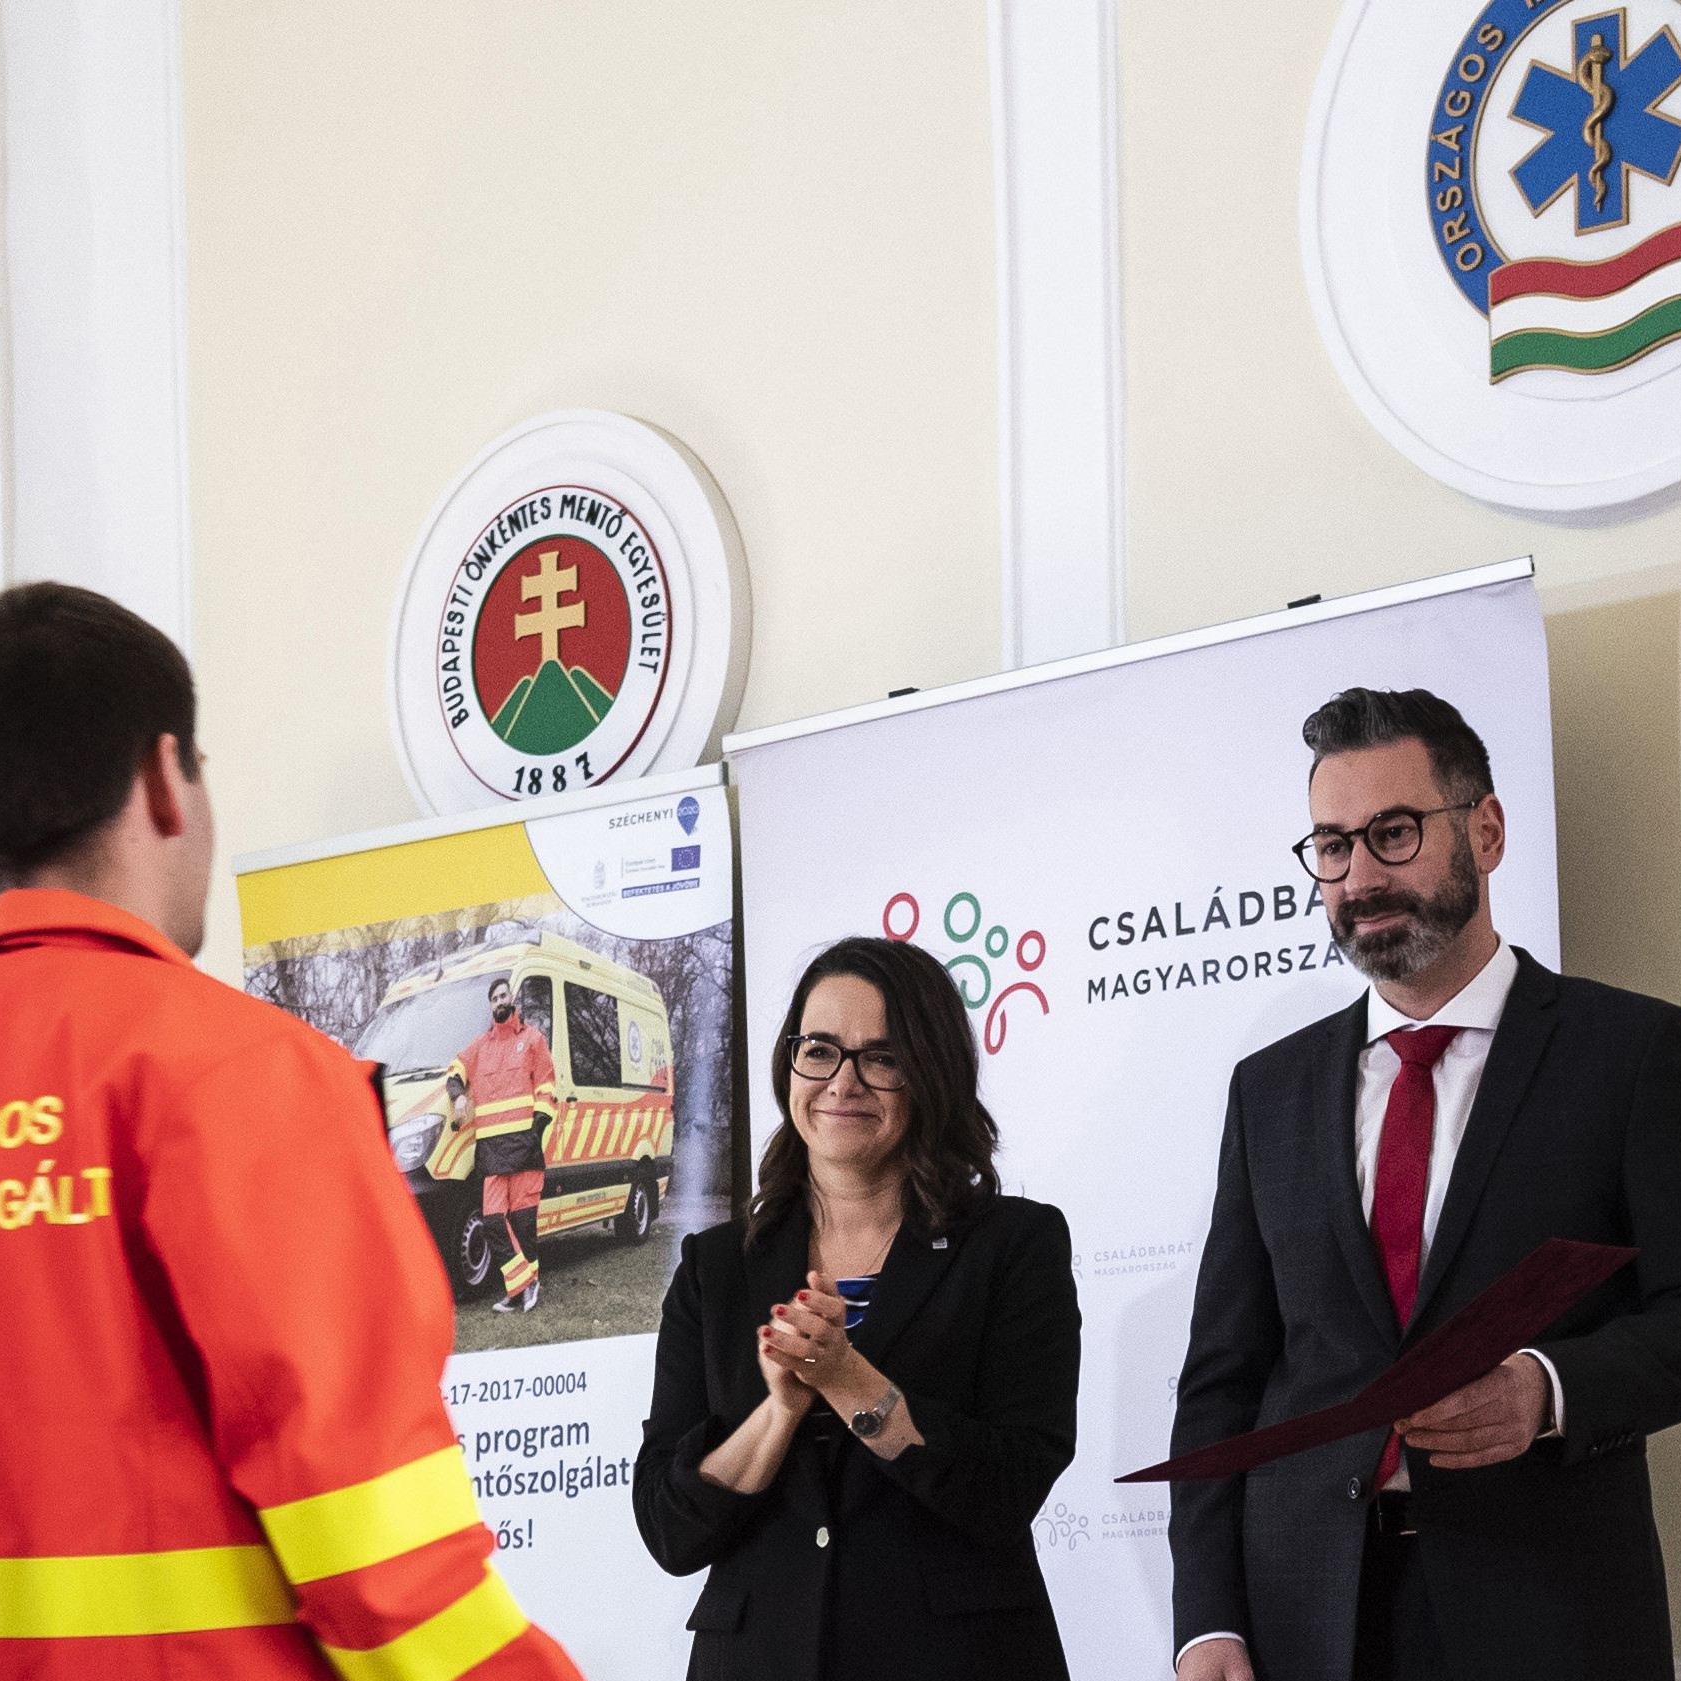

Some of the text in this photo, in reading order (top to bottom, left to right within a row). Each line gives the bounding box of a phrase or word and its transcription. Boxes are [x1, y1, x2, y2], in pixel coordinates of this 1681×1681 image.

[1430, 23, 1506, 273] ORSZÁGOS
[440, 493, 667, 729] BUDAPESTI ÖNKÉNTES MENTŐ EGYESÜLET
[512, 751, 595, 796] 1887
[608, 808, 674, 830] SZÉCHENYI
[1088, 880, 1326, 951] CSALÁDBA
[1094, 1241, 1193, 1262] CSALÁDBARÁT
[476, 1421, 591, 1462] program
[470, 1455, 631, 1499] ntőszolgálat
[496, 1518, 534, 1551] ős!
